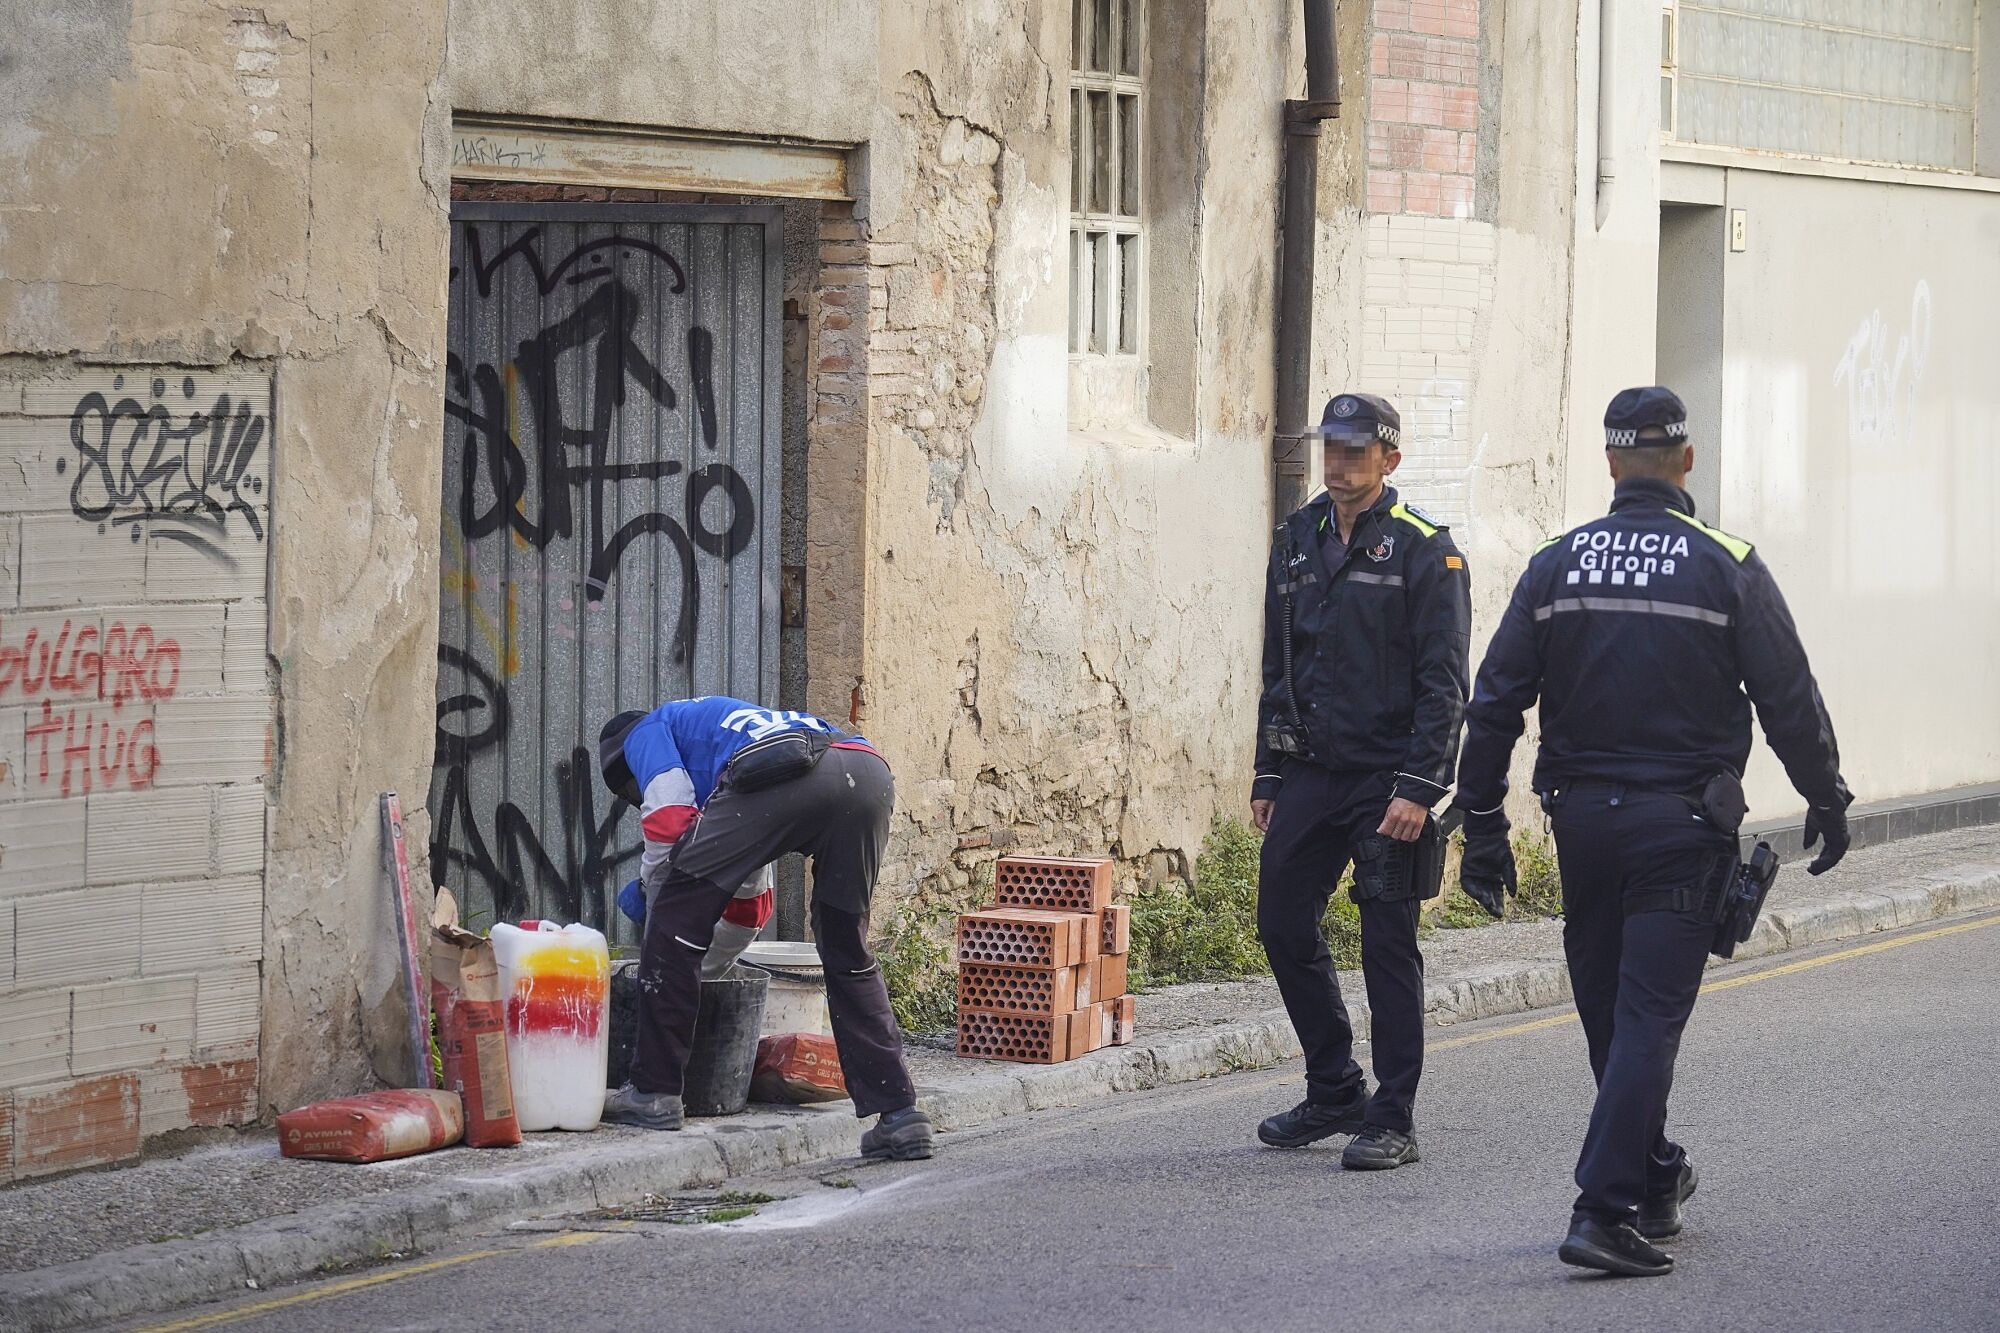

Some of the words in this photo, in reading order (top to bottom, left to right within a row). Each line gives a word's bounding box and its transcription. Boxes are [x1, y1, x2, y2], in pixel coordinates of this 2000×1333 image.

[1571, 531, 1690, 557] POLICIA
[1579, 551, 1676, 575] Girona
[26, 697, 162, 799] THUG
[304, 1129, 353, 1139] AYMAR
